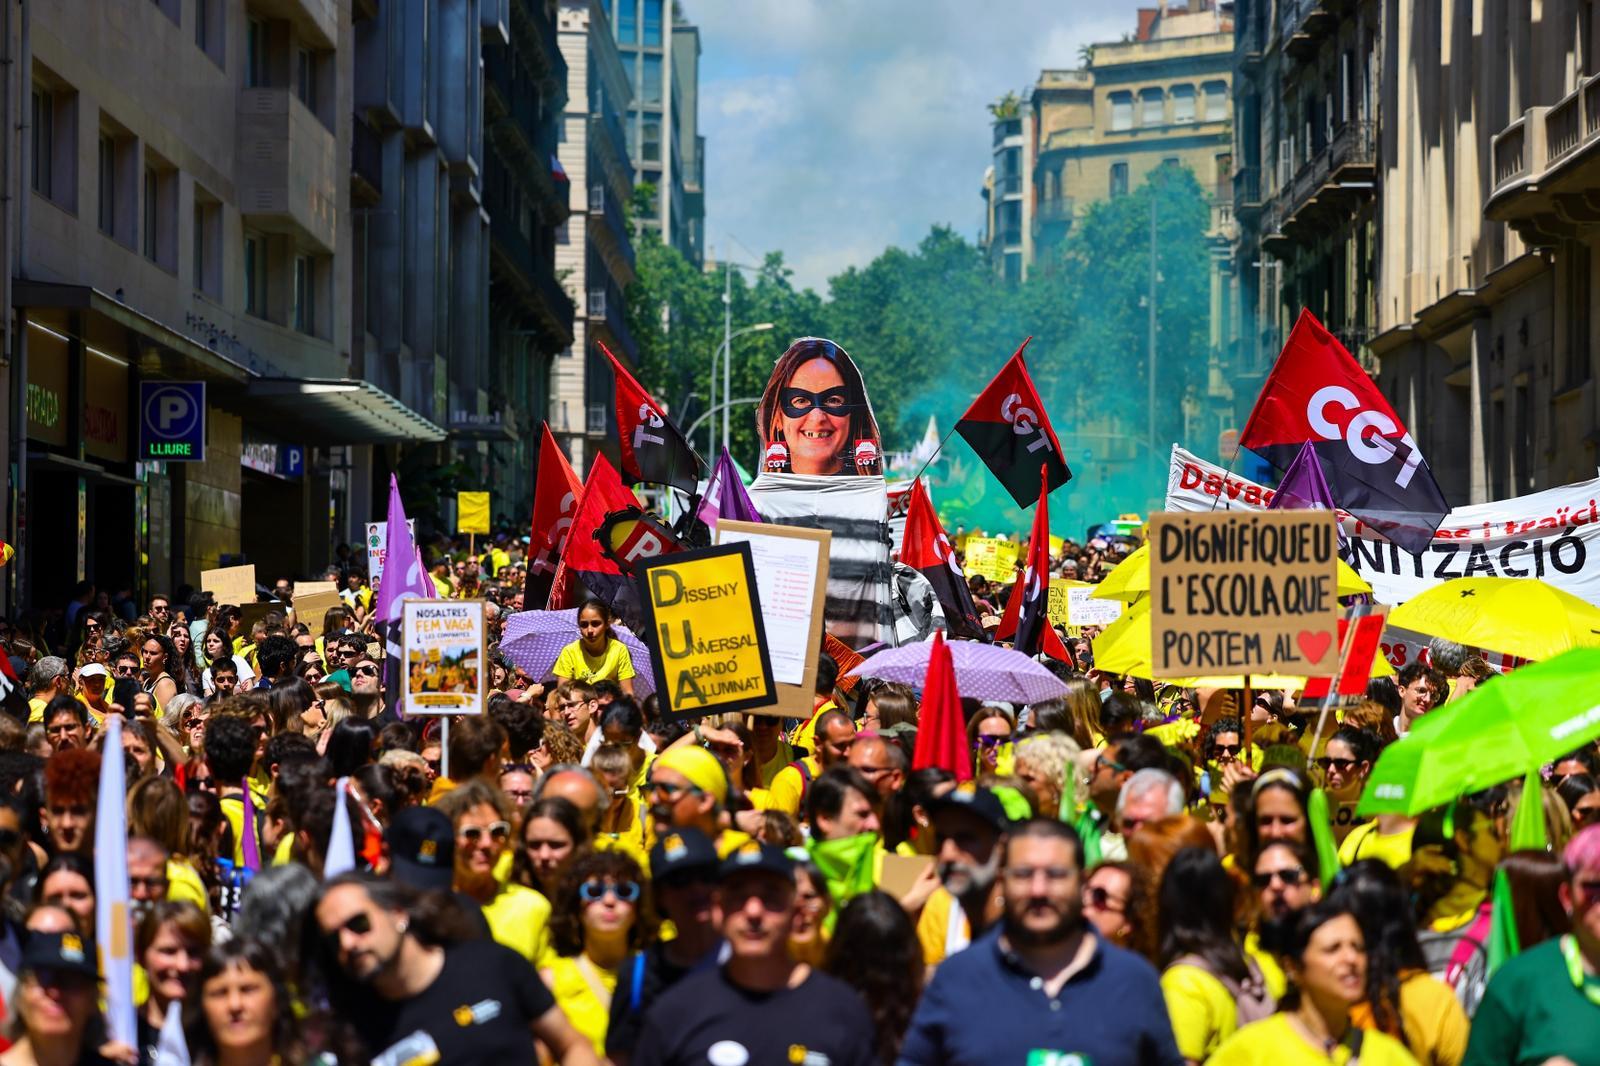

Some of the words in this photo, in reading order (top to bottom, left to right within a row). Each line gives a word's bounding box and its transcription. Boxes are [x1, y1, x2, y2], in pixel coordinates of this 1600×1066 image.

[160, 396, 188, 430] P
[1001, 393, 1053, 454] CGT
[1306, 385, 1426, 489] CGT
[150, 443, 192, 456] LLIURE
[290, 449, 300, 471] P
[767, 460, 786, 468] CGT
[857, 457, 876, 466] CGT
[1283, 575, 1330, 615] QUE
[416, 608, 468, 619] NOSALTRES
[416, 619, 441, 632] FEM
[444, 617, 474, 631] VAGA
[1163, 630, 1263, 669] PORTEM
[1273, 633, 1301, 663] AL
